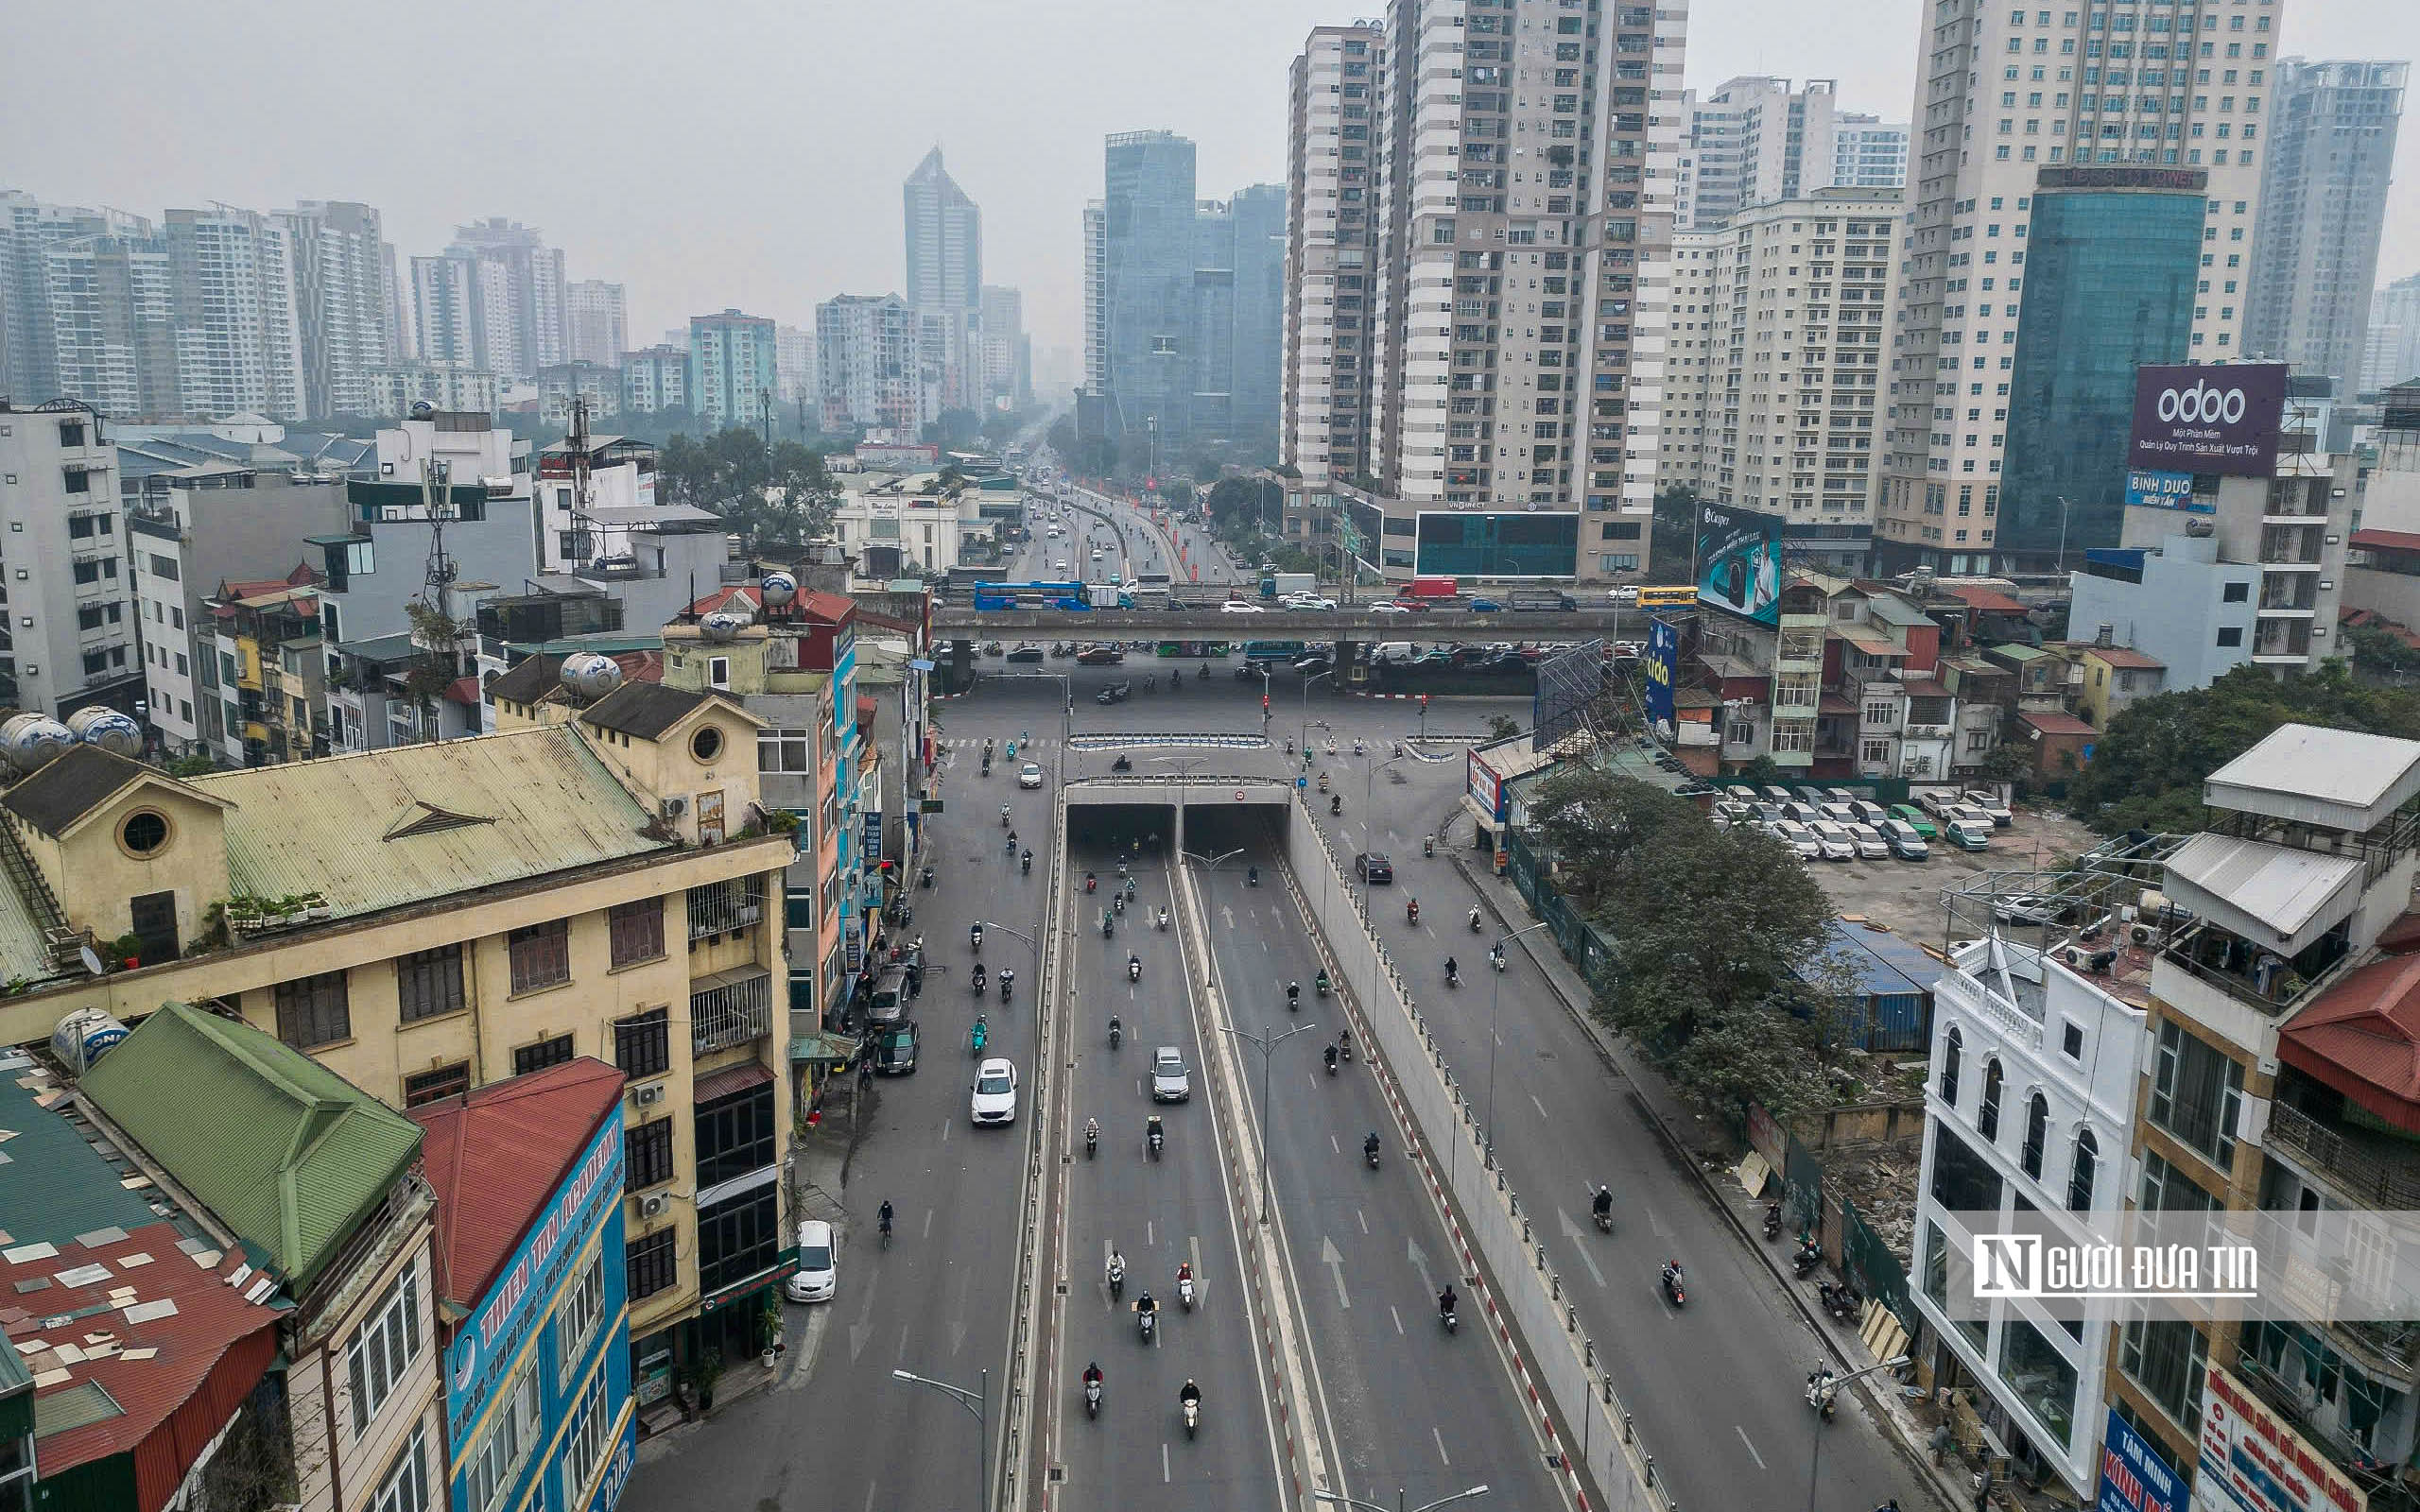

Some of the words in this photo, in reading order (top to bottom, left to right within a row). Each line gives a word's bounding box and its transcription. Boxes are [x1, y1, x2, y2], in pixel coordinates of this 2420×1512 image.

[2158, 378, 2246, 424] odoo
[1711, 511, 1730, 527] Casper
[480, 1255, 529, 1349] THIEN
[531, 1210, 560, 1274] TAN
[562, 1119, 619, 1232] ACADEMY
[2104, 1447, 2143, 1512] KÍNH
[2122, 1430, 2143, 1467] TÂM
[2144, 1455, 2171, 1497] MINH
